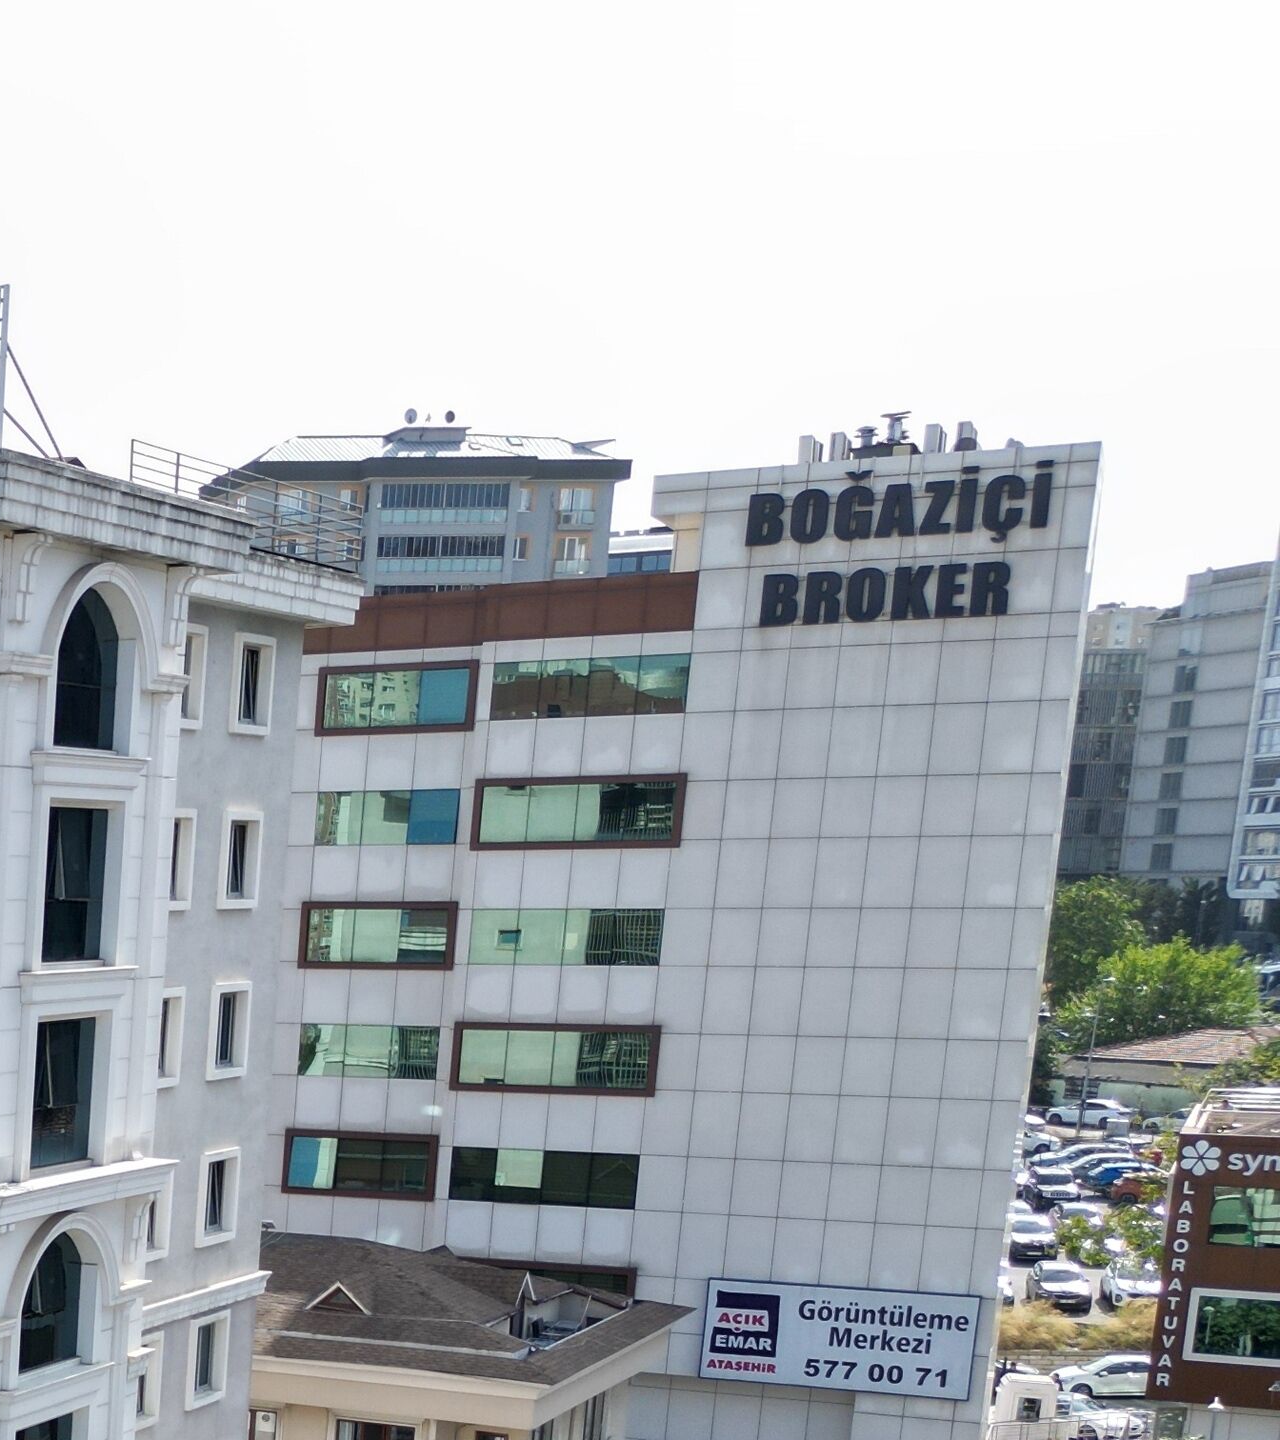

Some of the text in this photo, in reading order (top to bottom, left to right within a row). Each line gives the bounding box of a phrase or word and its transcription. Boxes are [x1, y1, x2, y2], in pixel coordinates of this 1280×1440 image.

[745, 459, 1054, 543] BOĞAZİÇİ
[759, 561, 1011, 627] BROKER
[1156, 1180, 1195, 1387] LABORATUVAR
[717, 1311, 766, 1332] AÇIK
[798, 1299, 970, 1332] Görüntüleme
[715, 1334, 772, 1351] EMAR
[828, 1326, 932, 1355] Merkezi
[804, 1358, 949, 1388] 577 00 71
